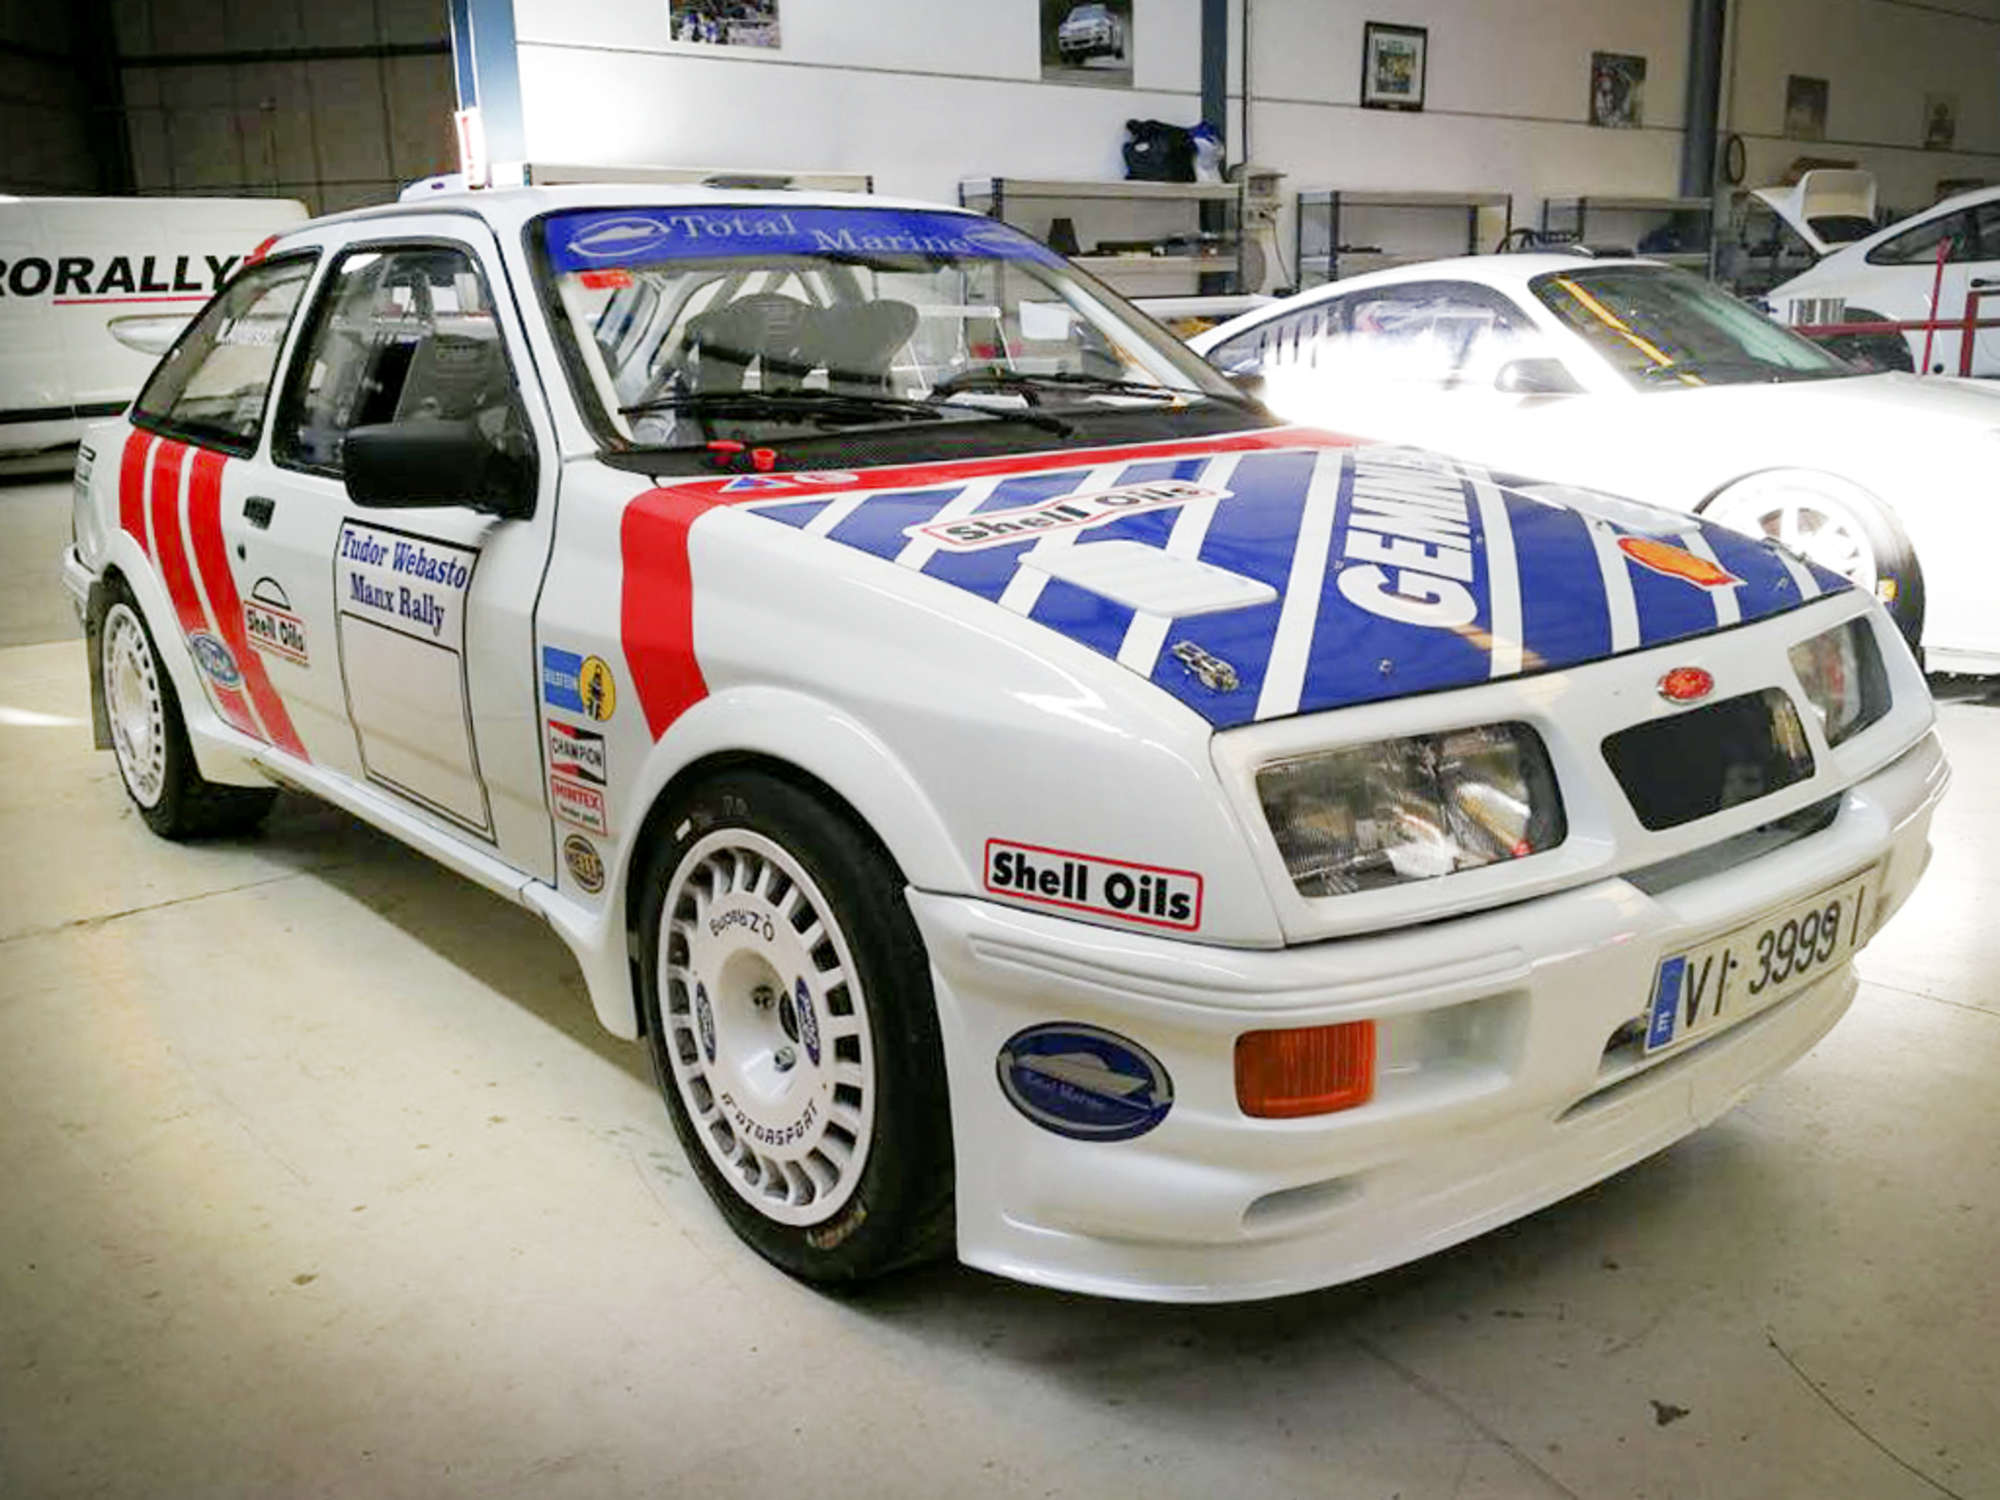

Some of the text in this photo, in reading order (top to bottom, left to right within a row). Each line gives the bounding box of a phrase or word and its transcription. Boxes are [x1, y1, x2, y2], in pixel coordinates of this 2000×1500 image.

[669, 213, 969, 252] Total Marine
[0, 255, 241, 297] ORALLY
[945, 505, 1092, 541] Shell
[341, 529, 468, 589] Tudor Webasto
[350, 572, 445, 637] Manx Rally
[551, 736, 603, 767] CHAMPION
[991, 851, 1192, 921] Shell Oils
[1685, 949, 1730, 1029] VI
[1748, 900, 1842, 995] 3999
